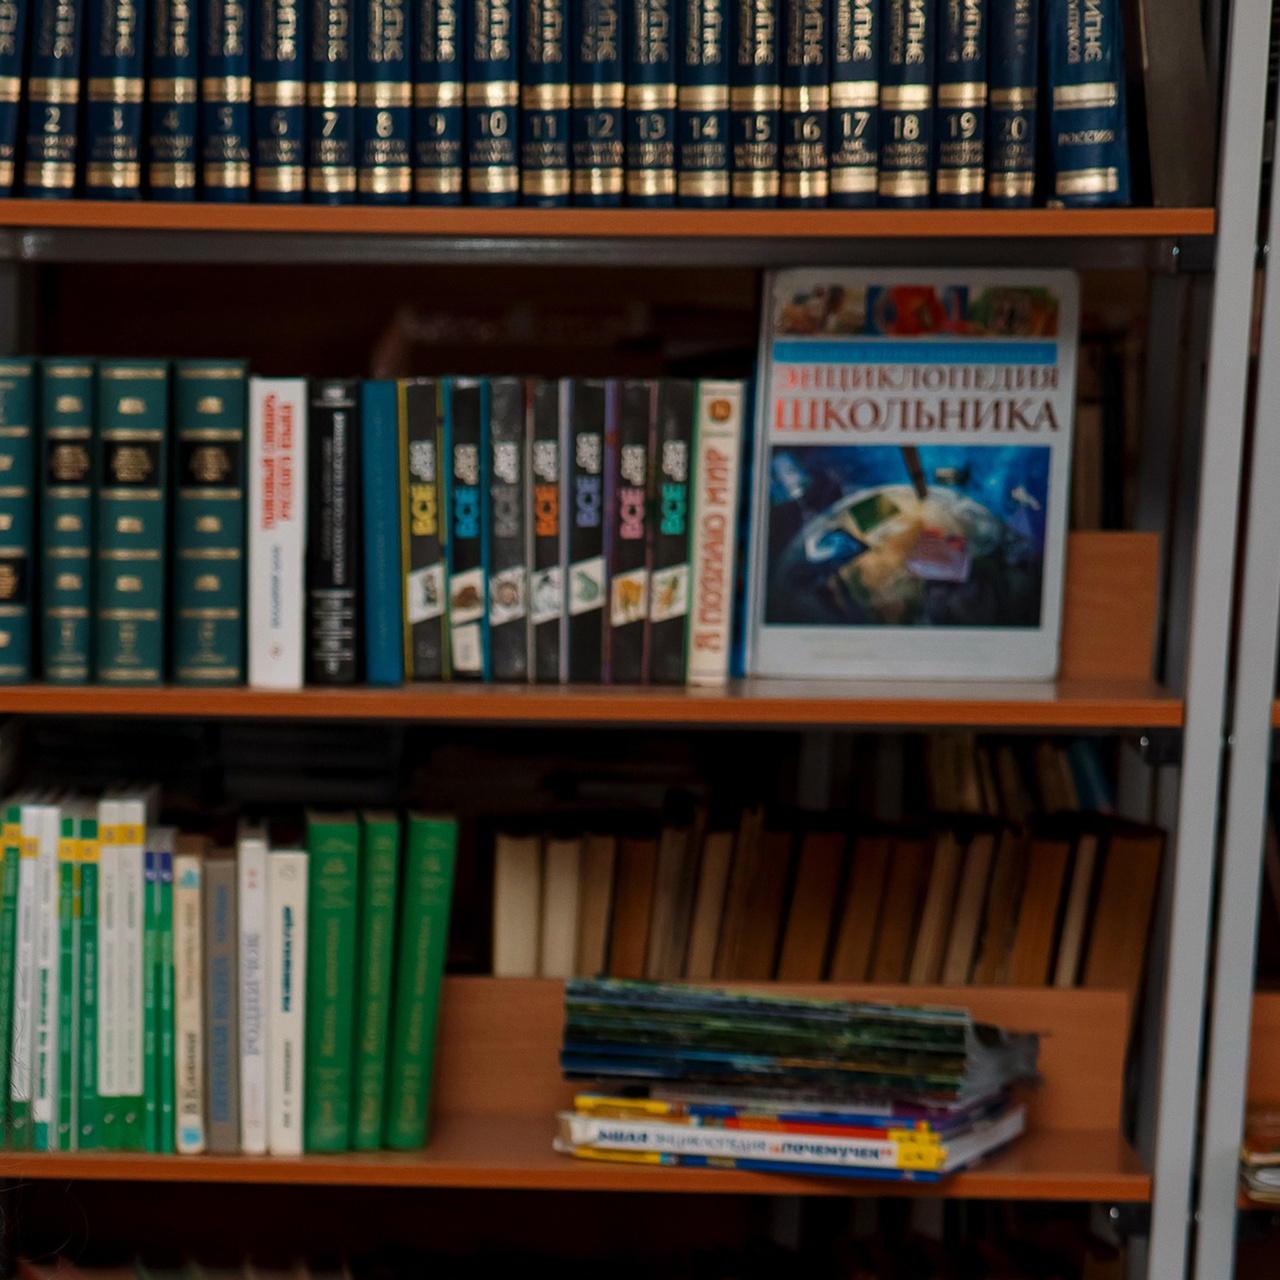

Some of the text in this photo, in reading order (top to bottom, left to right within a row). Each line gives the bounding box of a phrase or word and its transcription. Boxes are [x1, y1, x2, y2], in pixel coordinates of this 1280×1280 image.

[44, 107, 60, 133] 2
[322, 111, 339, 136] 7
[376, 111, 393, 137] 8
[480, 110, 507, 137] 10
[531, 115, 556, 139] 11
[584, 114, 615, 138] 12
[636, 114, 665, 139] 13
[690, 115, 718, 140] 14
[741, 115, 771, 140] 15
[792, 115, 820, 140] 16
[841, 112, 870, 136] 17
[892, 114, 919, 140] 18
[948, 112, 978, 138] 19
[1002, 116, 1027, 140] 20
[775, 365, 1059, 391] ЭНЦИКЛОПЕДИЯ
[774, 398, 1059, 432] ШКОЛЬНИКА
[695, 633, 721, 652] Я
